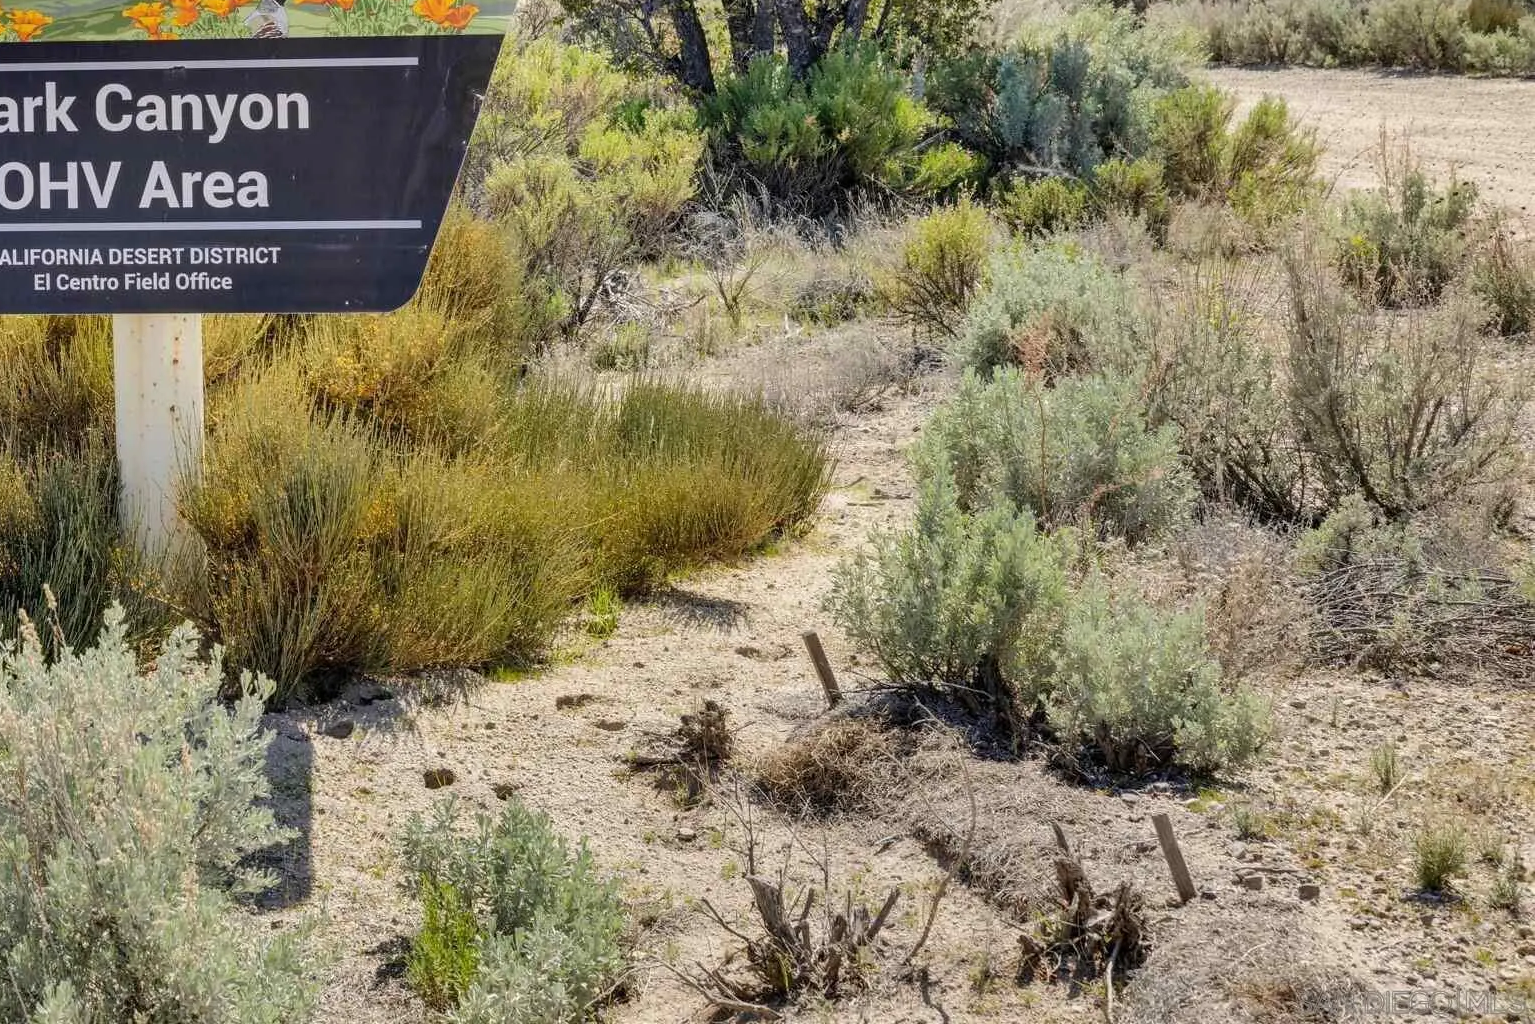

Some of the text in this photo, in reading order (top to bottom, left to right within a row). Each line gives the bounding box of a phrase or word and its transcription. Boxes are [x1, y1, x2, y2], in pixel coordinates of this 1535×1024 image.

[96, 83, 310, 144] Canyon
[139, 160, 270, 209] Area
[108, 247, 185, 265] DESERT
[190, 247, 282, 265] DISTRICT
[33, 271, 233, 291] El Centro Field Office
